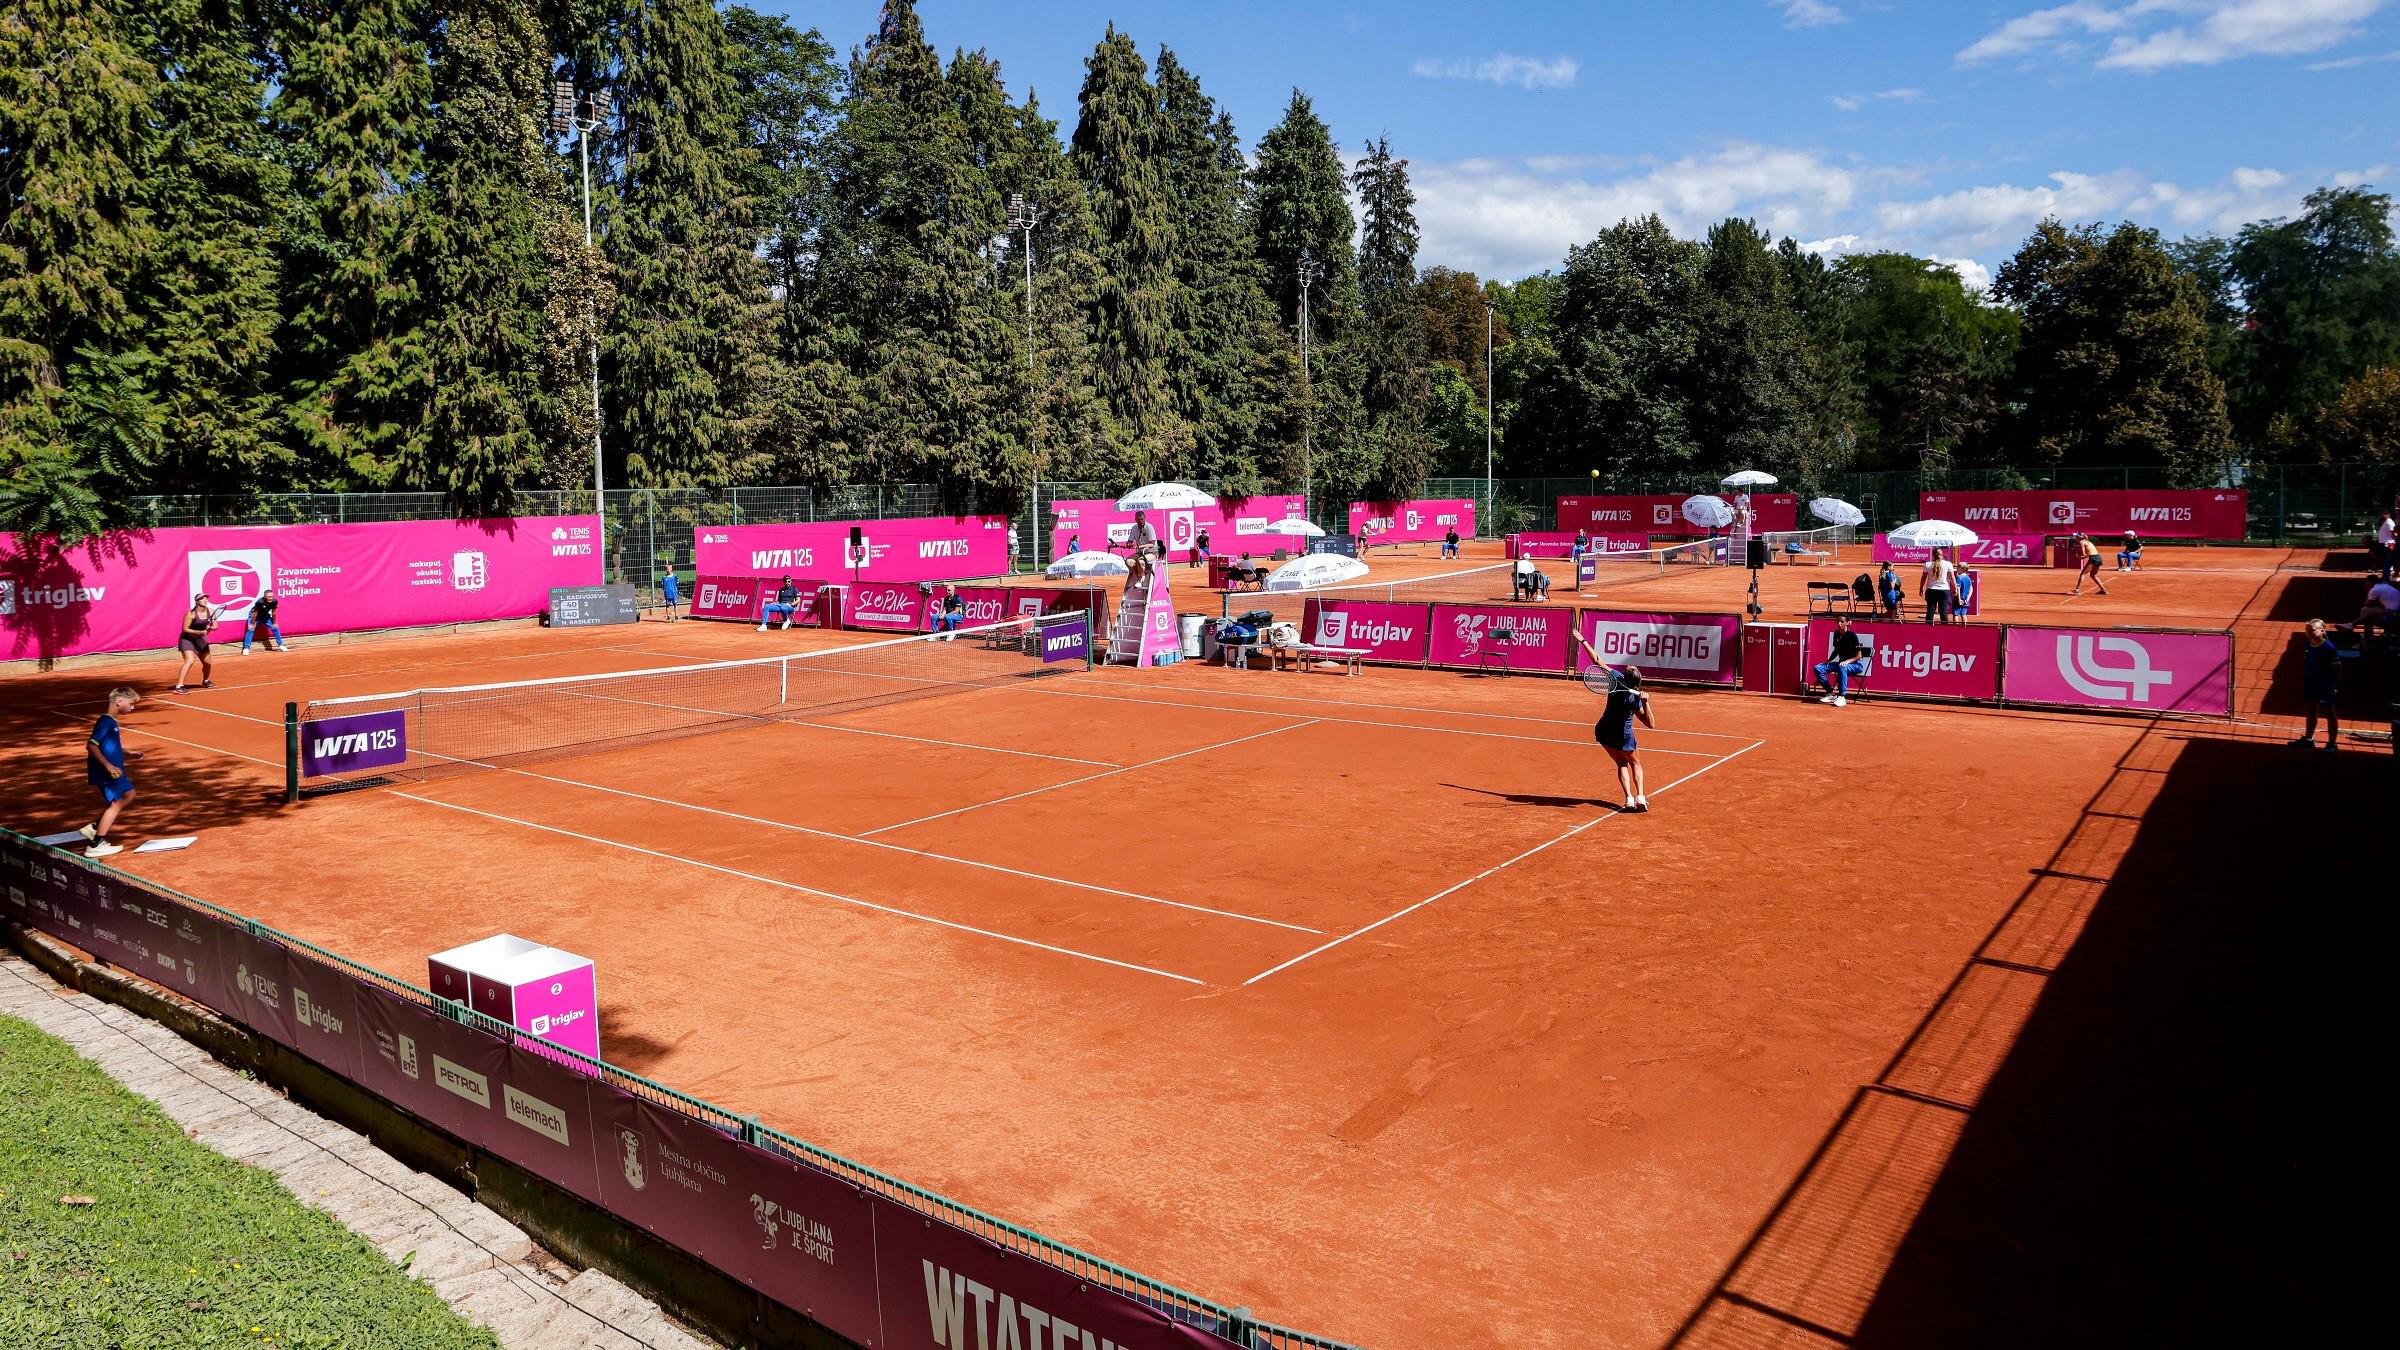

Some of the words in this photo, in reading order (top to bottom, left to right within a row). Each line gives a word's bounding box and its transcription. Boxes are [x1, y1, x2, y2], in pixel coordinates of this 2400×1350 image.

[1591, 510, 1617, 520] WTA
[1619, 510, 1632, 520] 125
[1964, 508, 1998, 520] WTA
[2000, 508, 2019, 520] 125
[2131, 508, 2169, 520] WTA
[2171, 508, 2191, 520] 125
[570, 527, 590, 535] TENIS
[1239, 522, 1265, 531] telemach
[552, 544, 578, 557] WTA
[578, 543, 591, 555] 125
[919, 540, 951, 558] WTA
[952, 539, 969, 556] 125
[1609, 540, 1641, 551] triglav
[1972, 540, 2028, 559] Zala
[752, 549, 792, 570] WTA
[793, 548, 813, 567] 125
[277, 565, 341, 577] Zavarovalnica
[1280, 570, 1299, 578] Zala
[277, 577, 310, 588] Triglav
[457, 576, 482, 587] BTC
[21, 583, 105, 609] triglav
[277, 587, 321, 599] Ljubljana
[717, 590, 748, 608] triglav
[855, 589, 914, 611] SLOPAK
[566, 601, 577, 609] 40
[929, 598, 1002, 620] slatch
[1488, 615, 1547, 631] LJUBLJANA
[1047, 635, 1071, 652] WTA
[1071, 633, 1083, 647] 125
[1351, 620, 1413, 646] triglav
[1511, 631, 1547, 647] ŠPORT
[1604, 631, 1641, 656] BIG
[1645, 633, 1709, 660] BANG
[1880, 644, 1976, 677] triglav
[314, 732, 368, 758] WTA
[370, 729, 397, 750] 125
[157, 953, 176, 971] EKIPA
[253, 974, 279, 999] TENIS
[553, 984, 560, 993] 2
[311, 1003, 343, 1034] triglav
[551, 1008, 585, 1028] triglav
[402, 1060, 417, 1075] BTC
[440, 1066, 484, 1096] PETROL
[510, 1095, 562, 1133] telemach
[658, 1142, 691, 1168] Mestna
[693, 1160, 728, 1186] občina
[660, 1161, 703, 1193] Ljubljana
[779, 1205, 835, 1246] LJUBLJANA
[791, 1231, 802, 1251] JE
[804, 1232, 835, 1266] ŠPORT
[922, 1258, 1131, 1350] WTAT
